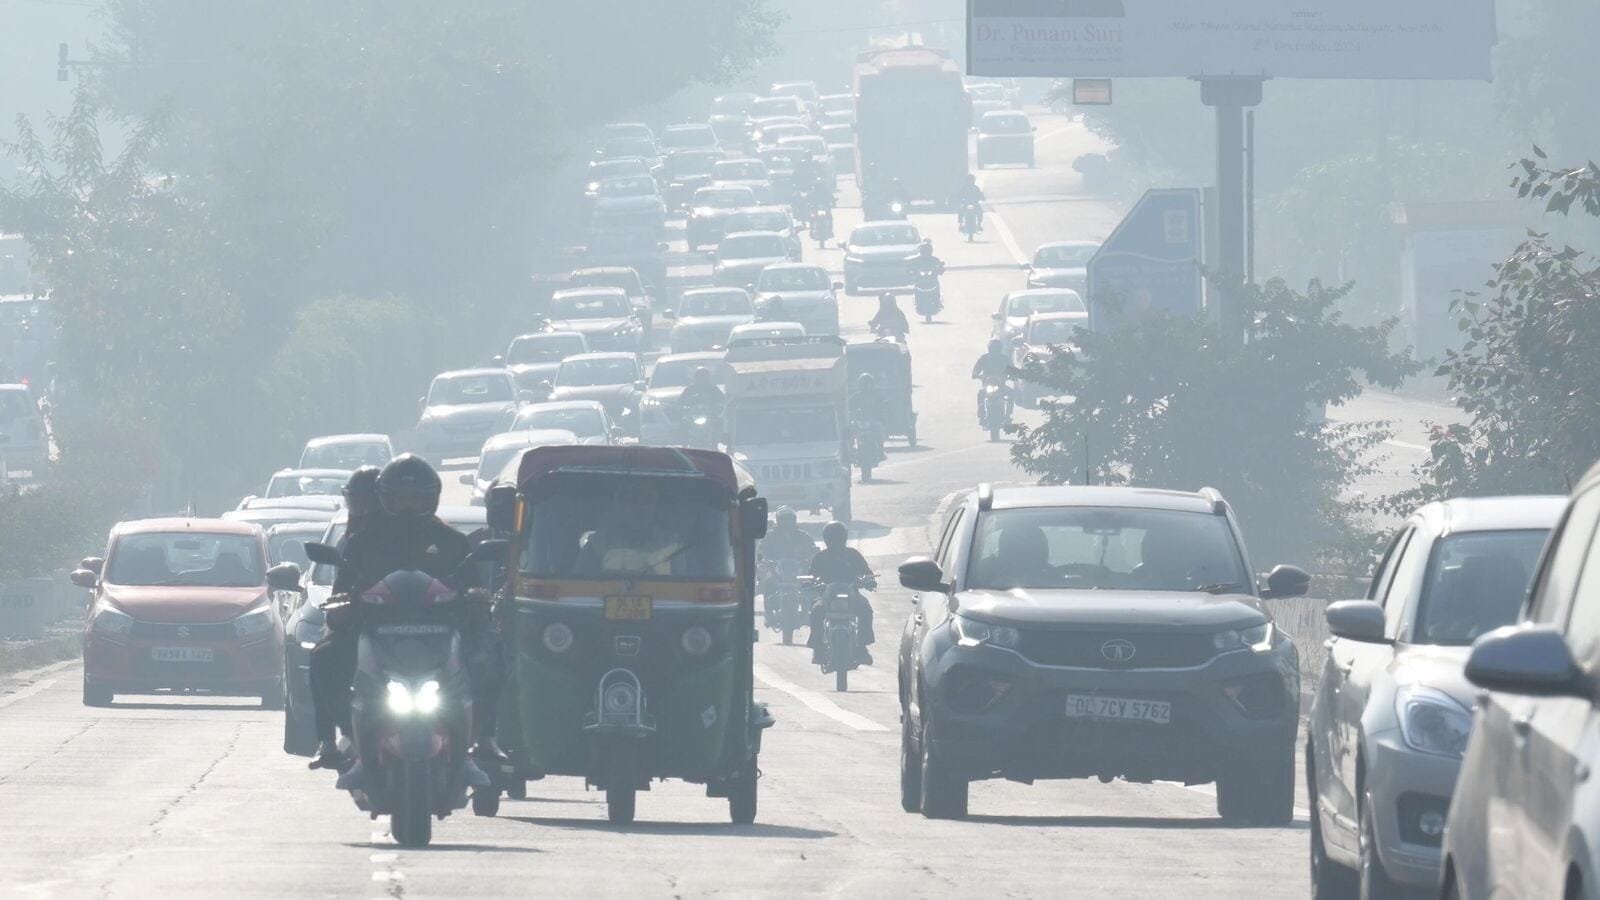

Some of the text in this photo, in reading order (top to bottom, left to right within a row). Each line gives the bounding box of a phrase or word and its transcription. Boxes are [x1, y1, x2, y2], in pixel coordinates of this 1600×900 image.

[975, 24, 1122, 42] Dr. Punam Suri
[1099, 699, 1127, 717] 7CY
[1132, 702, 1169, 720] 5762
